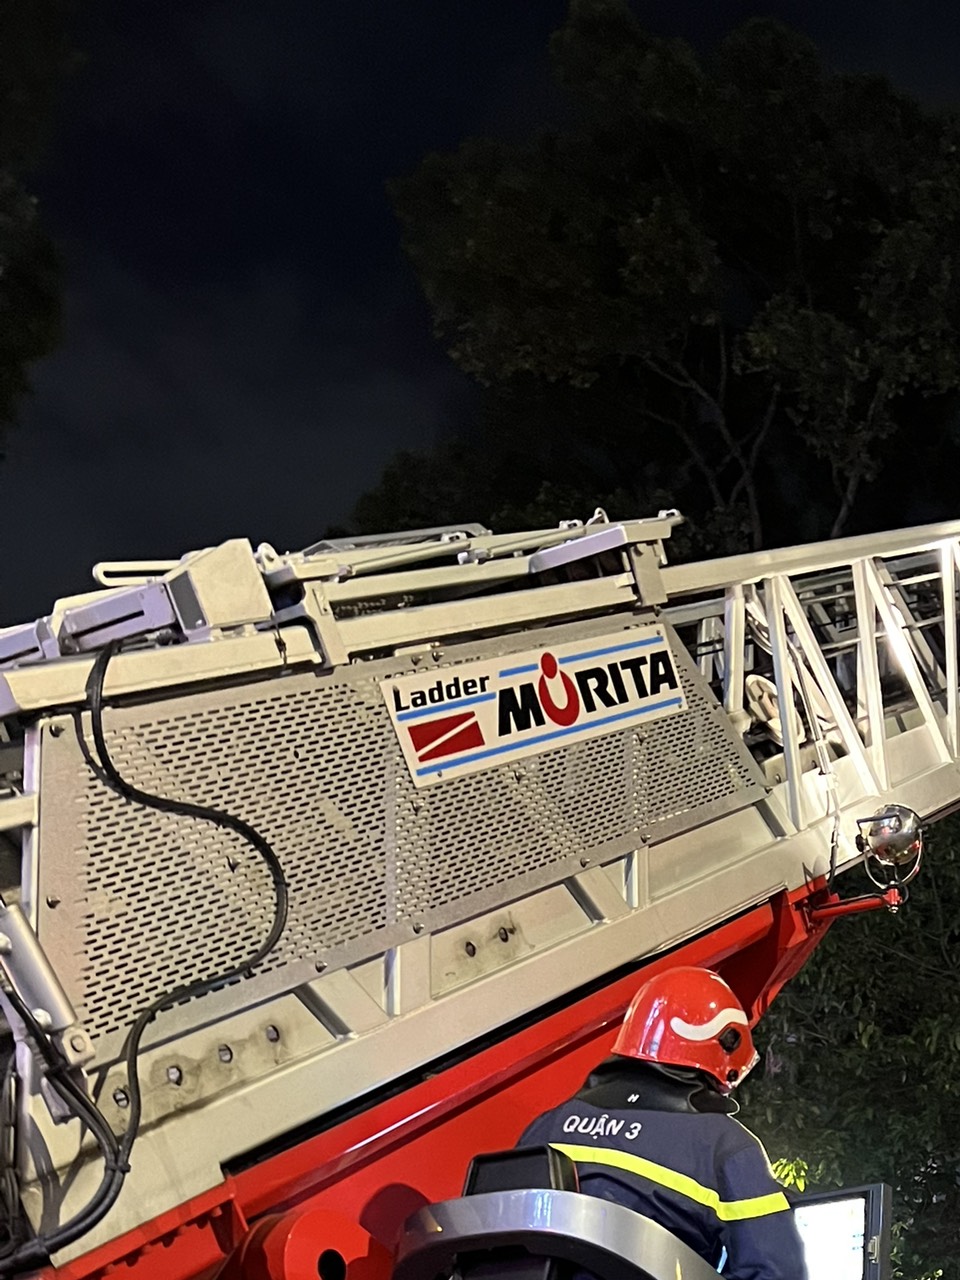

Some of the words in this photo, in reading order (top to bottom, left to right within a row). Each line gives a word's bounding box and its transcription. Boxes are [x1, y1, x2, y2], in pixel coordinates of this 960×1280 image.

[393, 675, 490, 712] Ladder
[498, 651, 679, 737] MORITA
[563, 1114, 625, 1139] QUẬN
[625, 1122, 642, 1140] 3
